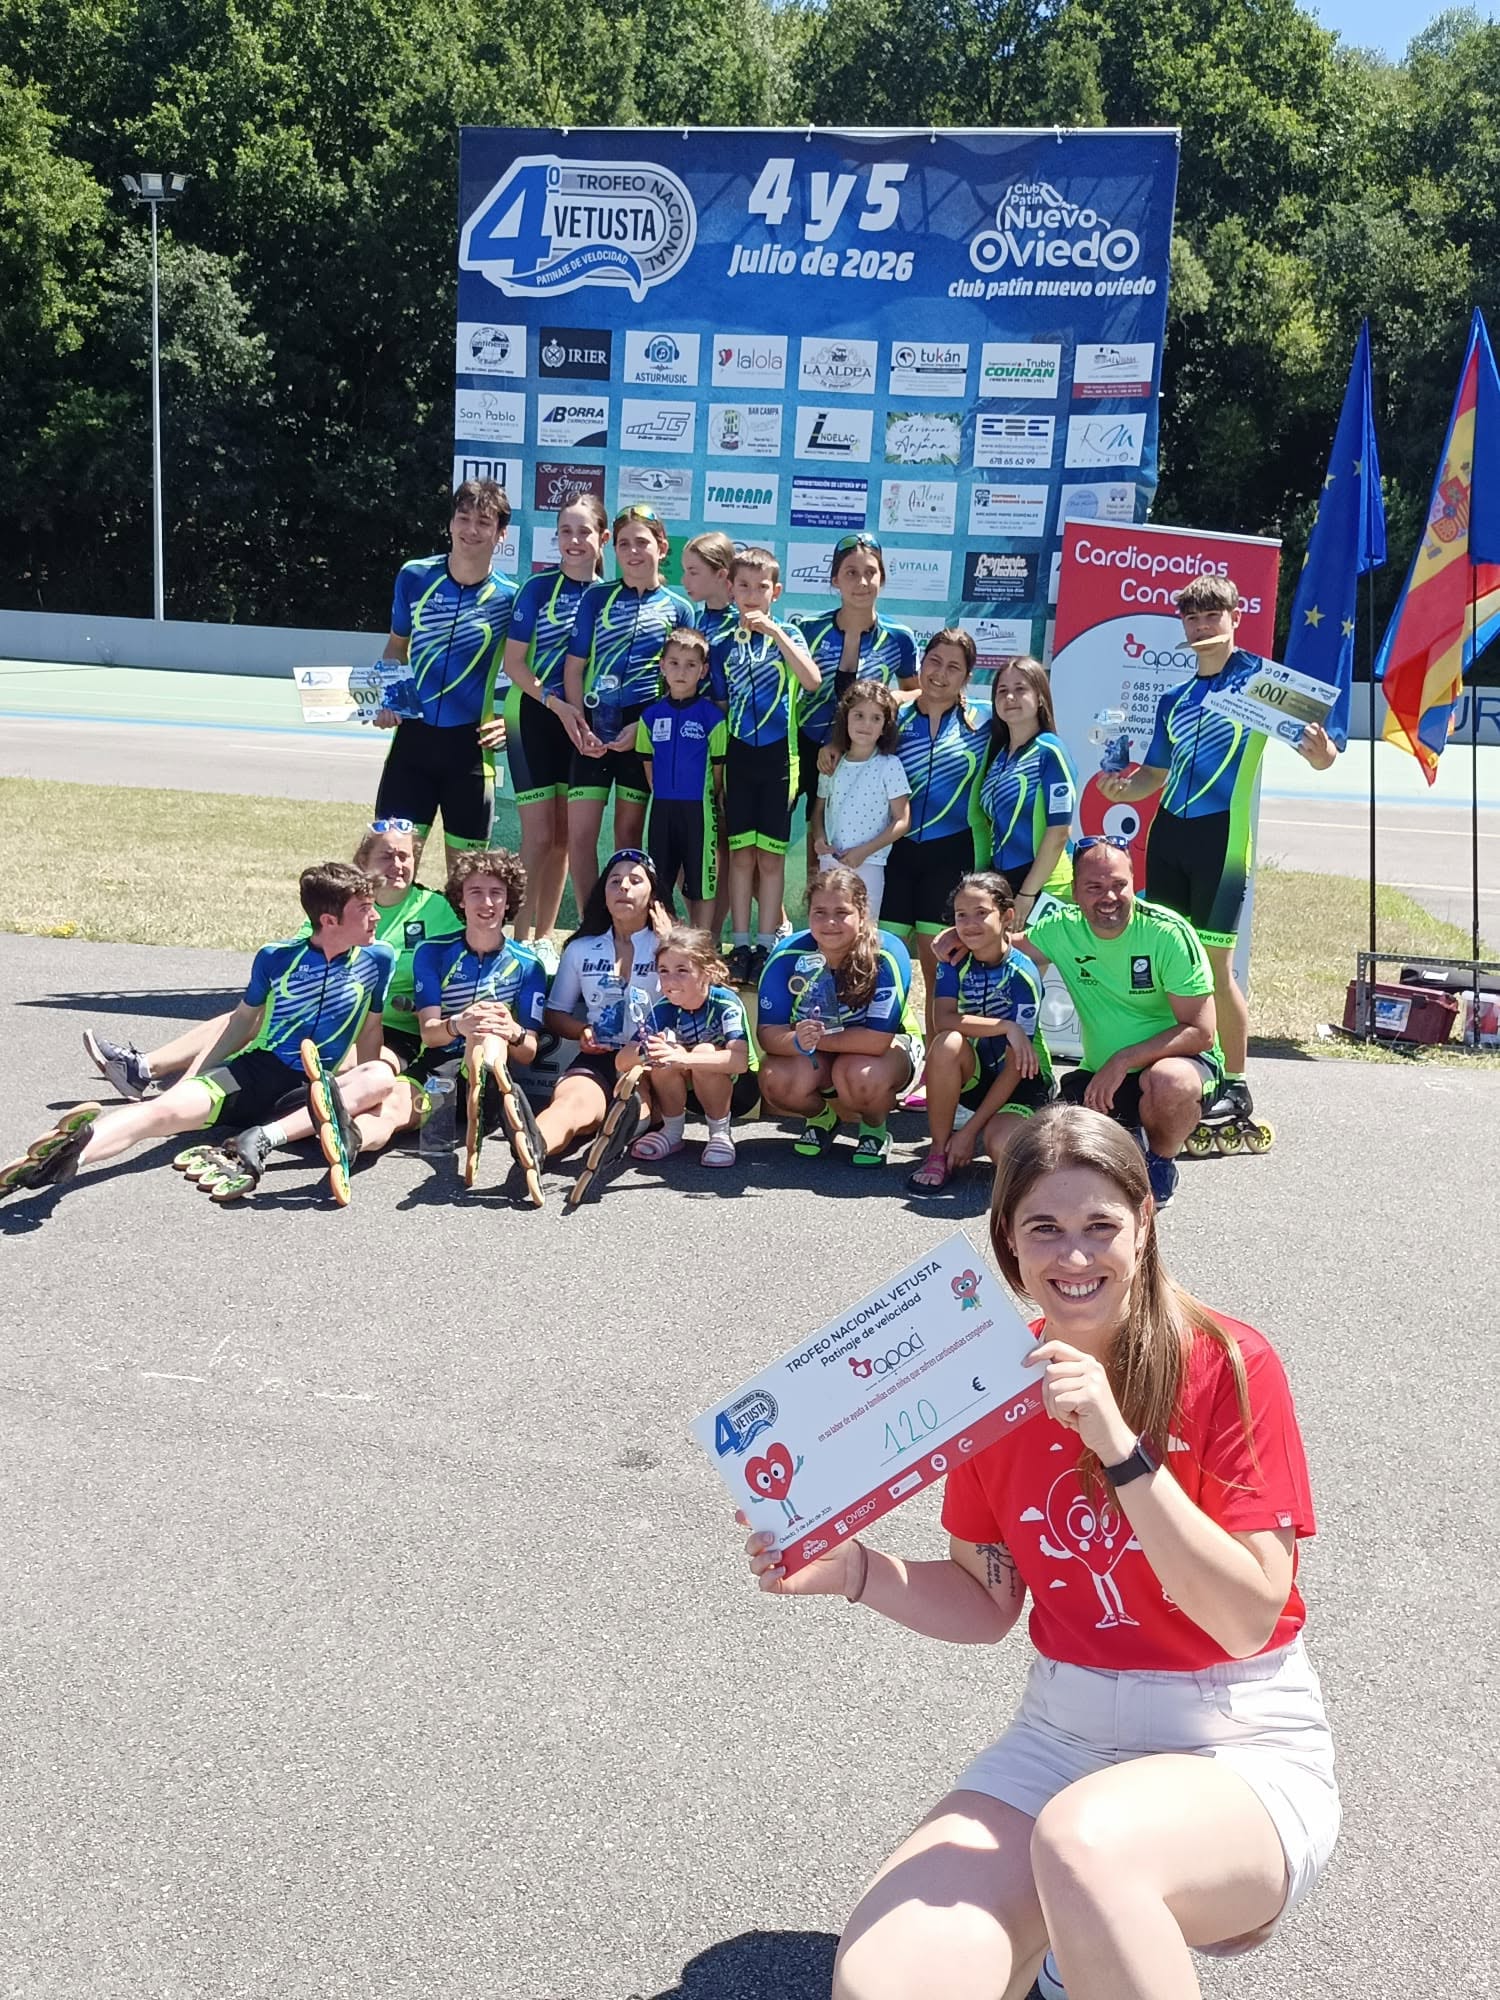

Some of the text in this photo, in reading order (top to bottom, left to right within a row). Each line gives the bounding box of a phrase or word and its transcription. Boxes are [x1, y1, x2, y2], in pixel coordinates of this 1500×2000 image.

[748, 158, 910, 243] 4 y 5
[1014, 183, 1040, 196] Club
[553, 204, 657, 243] VETUSTA
[576, 173, 685, 273] TROFEO NACIONAL
[1004, 205, 1097, 230] Nuevo
[535, 249, 630, 287] PATINAJE DE VELOCIDAD
[727, 243, 915, 283] Julio de 2026
[948, 278, 985, 299] club
[1035, 280, 1093, 298] nuevo
[1094, 276, 1157, 297] oviedo
[567, 347, 608, 366] IRIER
[736, 347, 783, 370] lalola
[920, 347, 961, 364] tukán
[635, 371, 688, 384] ASTURMUSIC
[802, 363, 872, 378] LA ALDEA
[984, 366, 1055, 378] COVIRAN
[459, 408, 516, 422] San Pablo
[552, 406, 604, 423] BORRA
[748, 407, 760, 416] BAR
[989, 457, 1036, 466] 678 65 62 99
[898, 561, 940, 572] VITALIA
[1074, 540, 1229, 578] Cardiopatías
[1132, 692, 1150, 703] 686
[1133, 681, 1165, 693] 685 93
[1130, 702, 1149, 713] 630
[785, 1338, 832, 1374] TROFEO
[831, 1297, 890, 1342] NACIONAL
[888, 1260, 942, 1301] VETUSTA
[820, 1292, 922, 1368] Patinaje de velocidad
[872, 1326, 927, 1376] apaci
[816, 1432, 825, 1442] en
[823, 1428, 832, 1438] su
[829, 1420, 844, 1433] labor
[841, 1415, 851, 1425] de
[848, 1405, 866, 1421] ayuda
[866, 1390, 888, 1408] familias
[885, 1383, 897, 1395] con
[908, 1367, 921, 1380] que
[918, 1356, 936, 1372] sufren
[934, 1336, 967, 1363] cardiopatías
[963, 1317, 994, 1342] congénitas
[971, 1376, 986, 1393] €
[734, 1401, 768, 1432] VETUSTA
[884, 1397, 939, 1454] 120
[845, 1499, 878, 1525] OVIEDO
